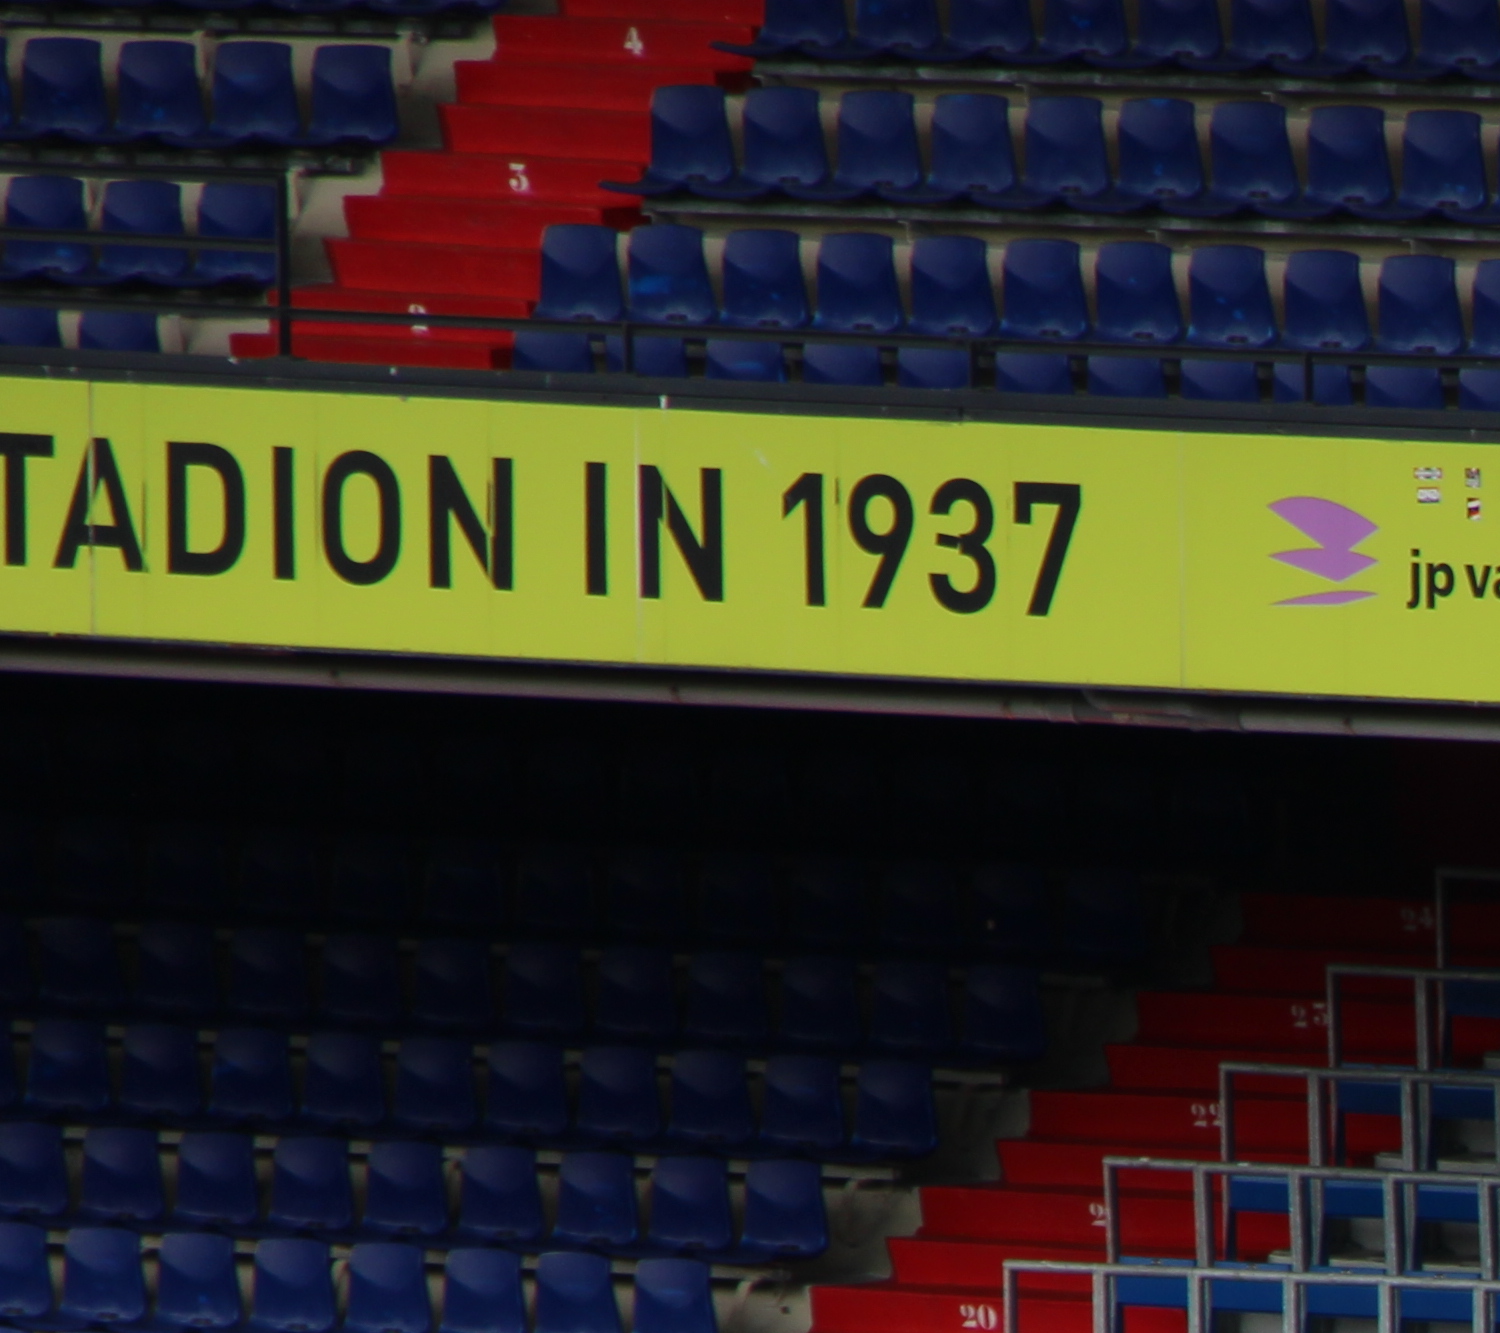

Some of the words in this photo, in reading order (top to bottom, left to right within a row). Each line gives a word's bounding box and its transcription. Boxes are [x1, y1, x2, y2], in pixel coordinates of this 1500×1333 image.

[624, 27, 644, 55] 4
[509, 162, 529, 192] 3
[0, 432, 514, 591] TADION
[585, 461, 724, 602] IN
[782, 470, 1081, 618] 1937
[1406, 548, 1456, 611] jp
[959, 1304, 997, 1330] 20
